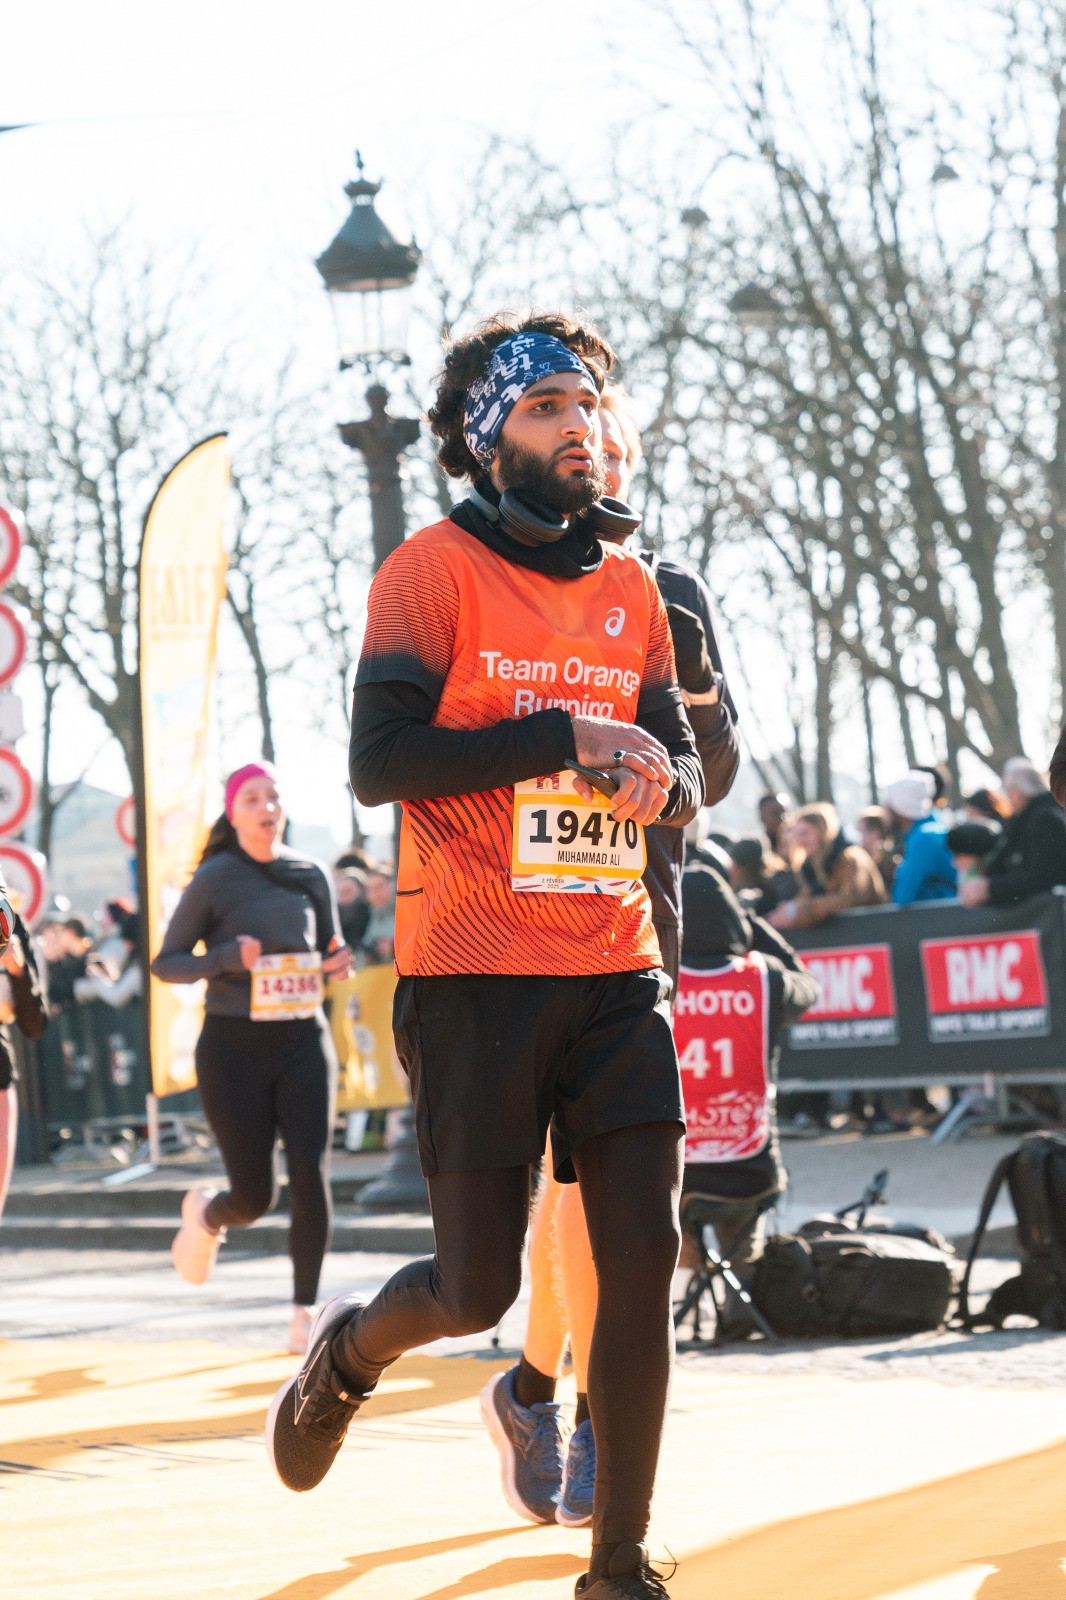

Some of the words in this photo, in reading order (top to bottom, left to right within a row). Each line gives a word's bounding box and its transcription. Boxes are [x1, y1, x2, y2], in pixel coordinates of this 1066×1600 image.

[480, 651, 556, 683] Team
[563, 656, 640, 697] Orange
[530, 810, 637, 849] 19470
[557, 850, 608, 865] MUHAMMAD
[609, 853, 621, 866] ALI
[945, 941, 1023, 1005] RMC
[676, 989, 755, 1016] HOTO
[679, 1037, 735, 1079] 41
